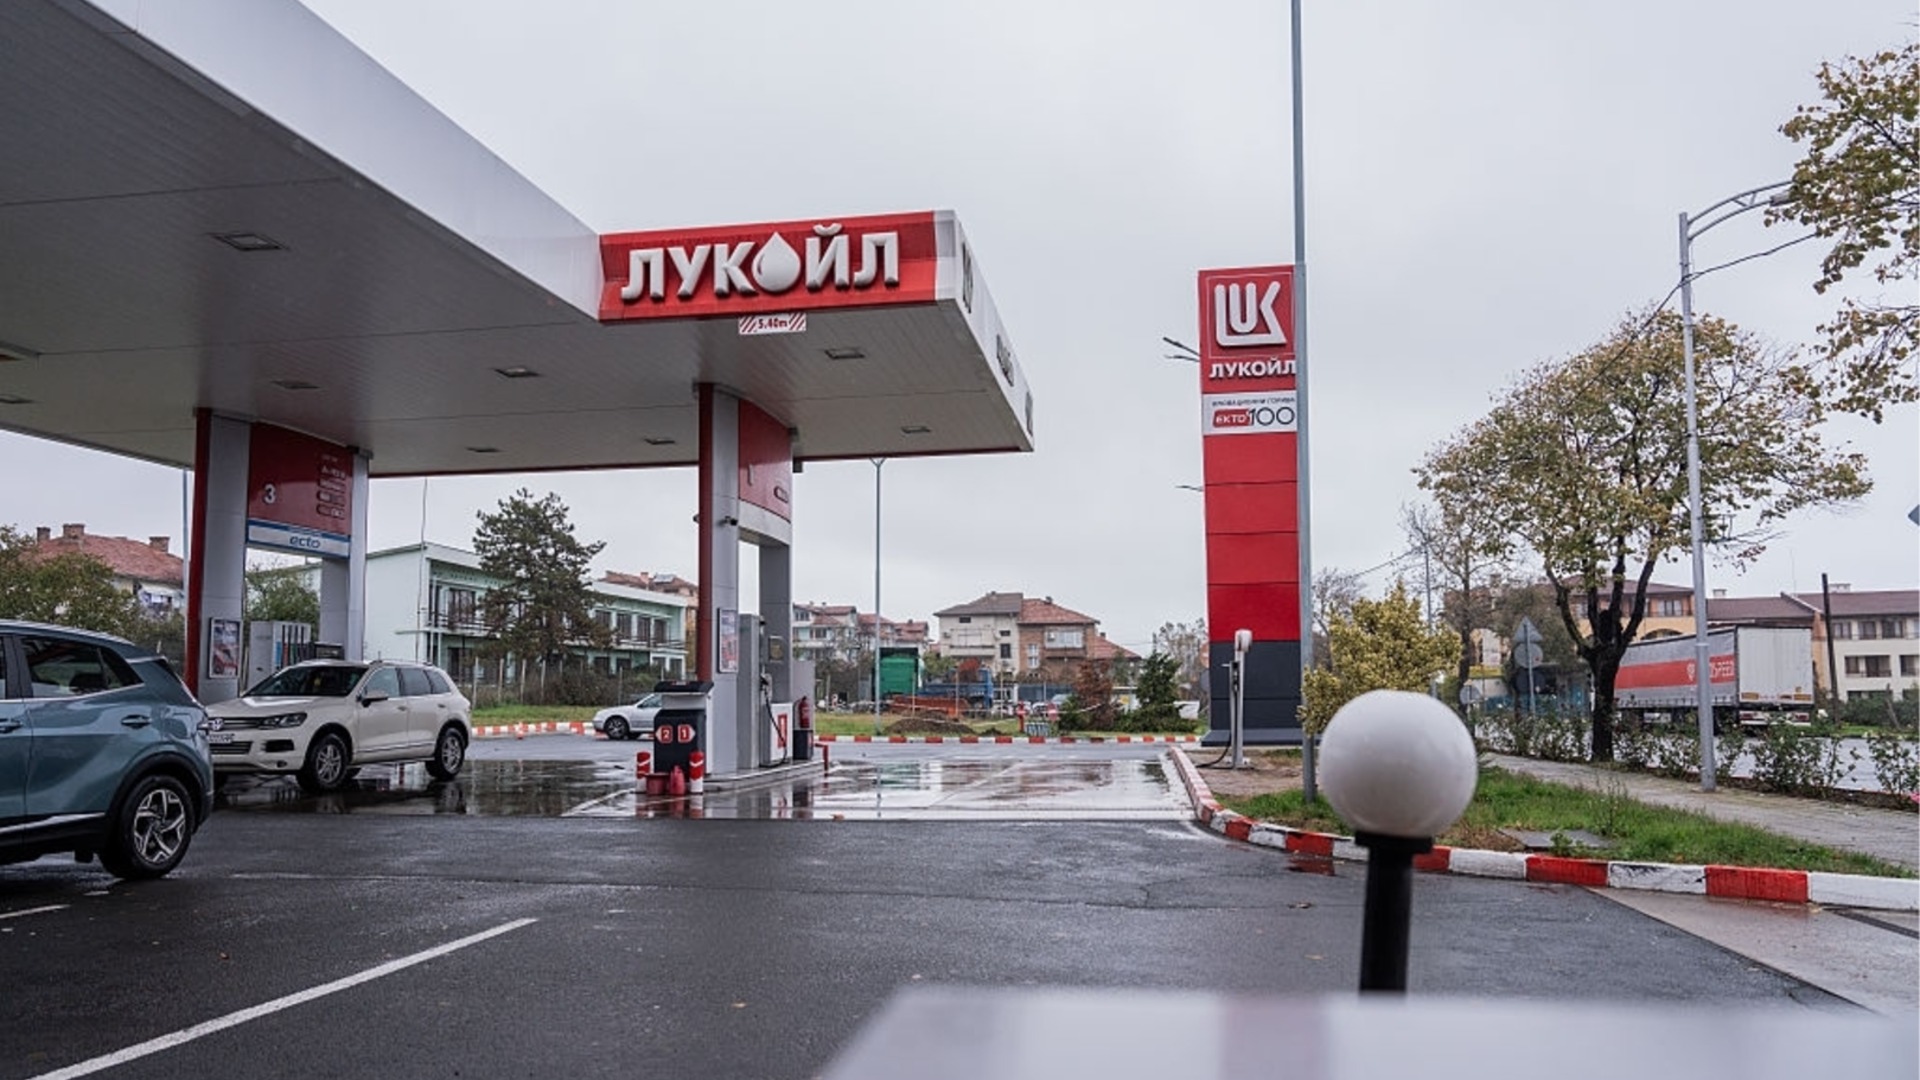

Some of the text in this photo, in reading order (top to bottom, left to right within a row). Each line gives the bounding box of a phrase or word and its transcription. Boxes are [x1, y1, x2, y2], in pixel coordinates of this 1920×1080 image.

[621, 223, 899, 300] ЛУКОЙЛ
[1209, 357, 1297, 378] ЛУКОЙЛ
[264, 483, 276, 504] 3
[662, 729, 687, 740] 2 1
